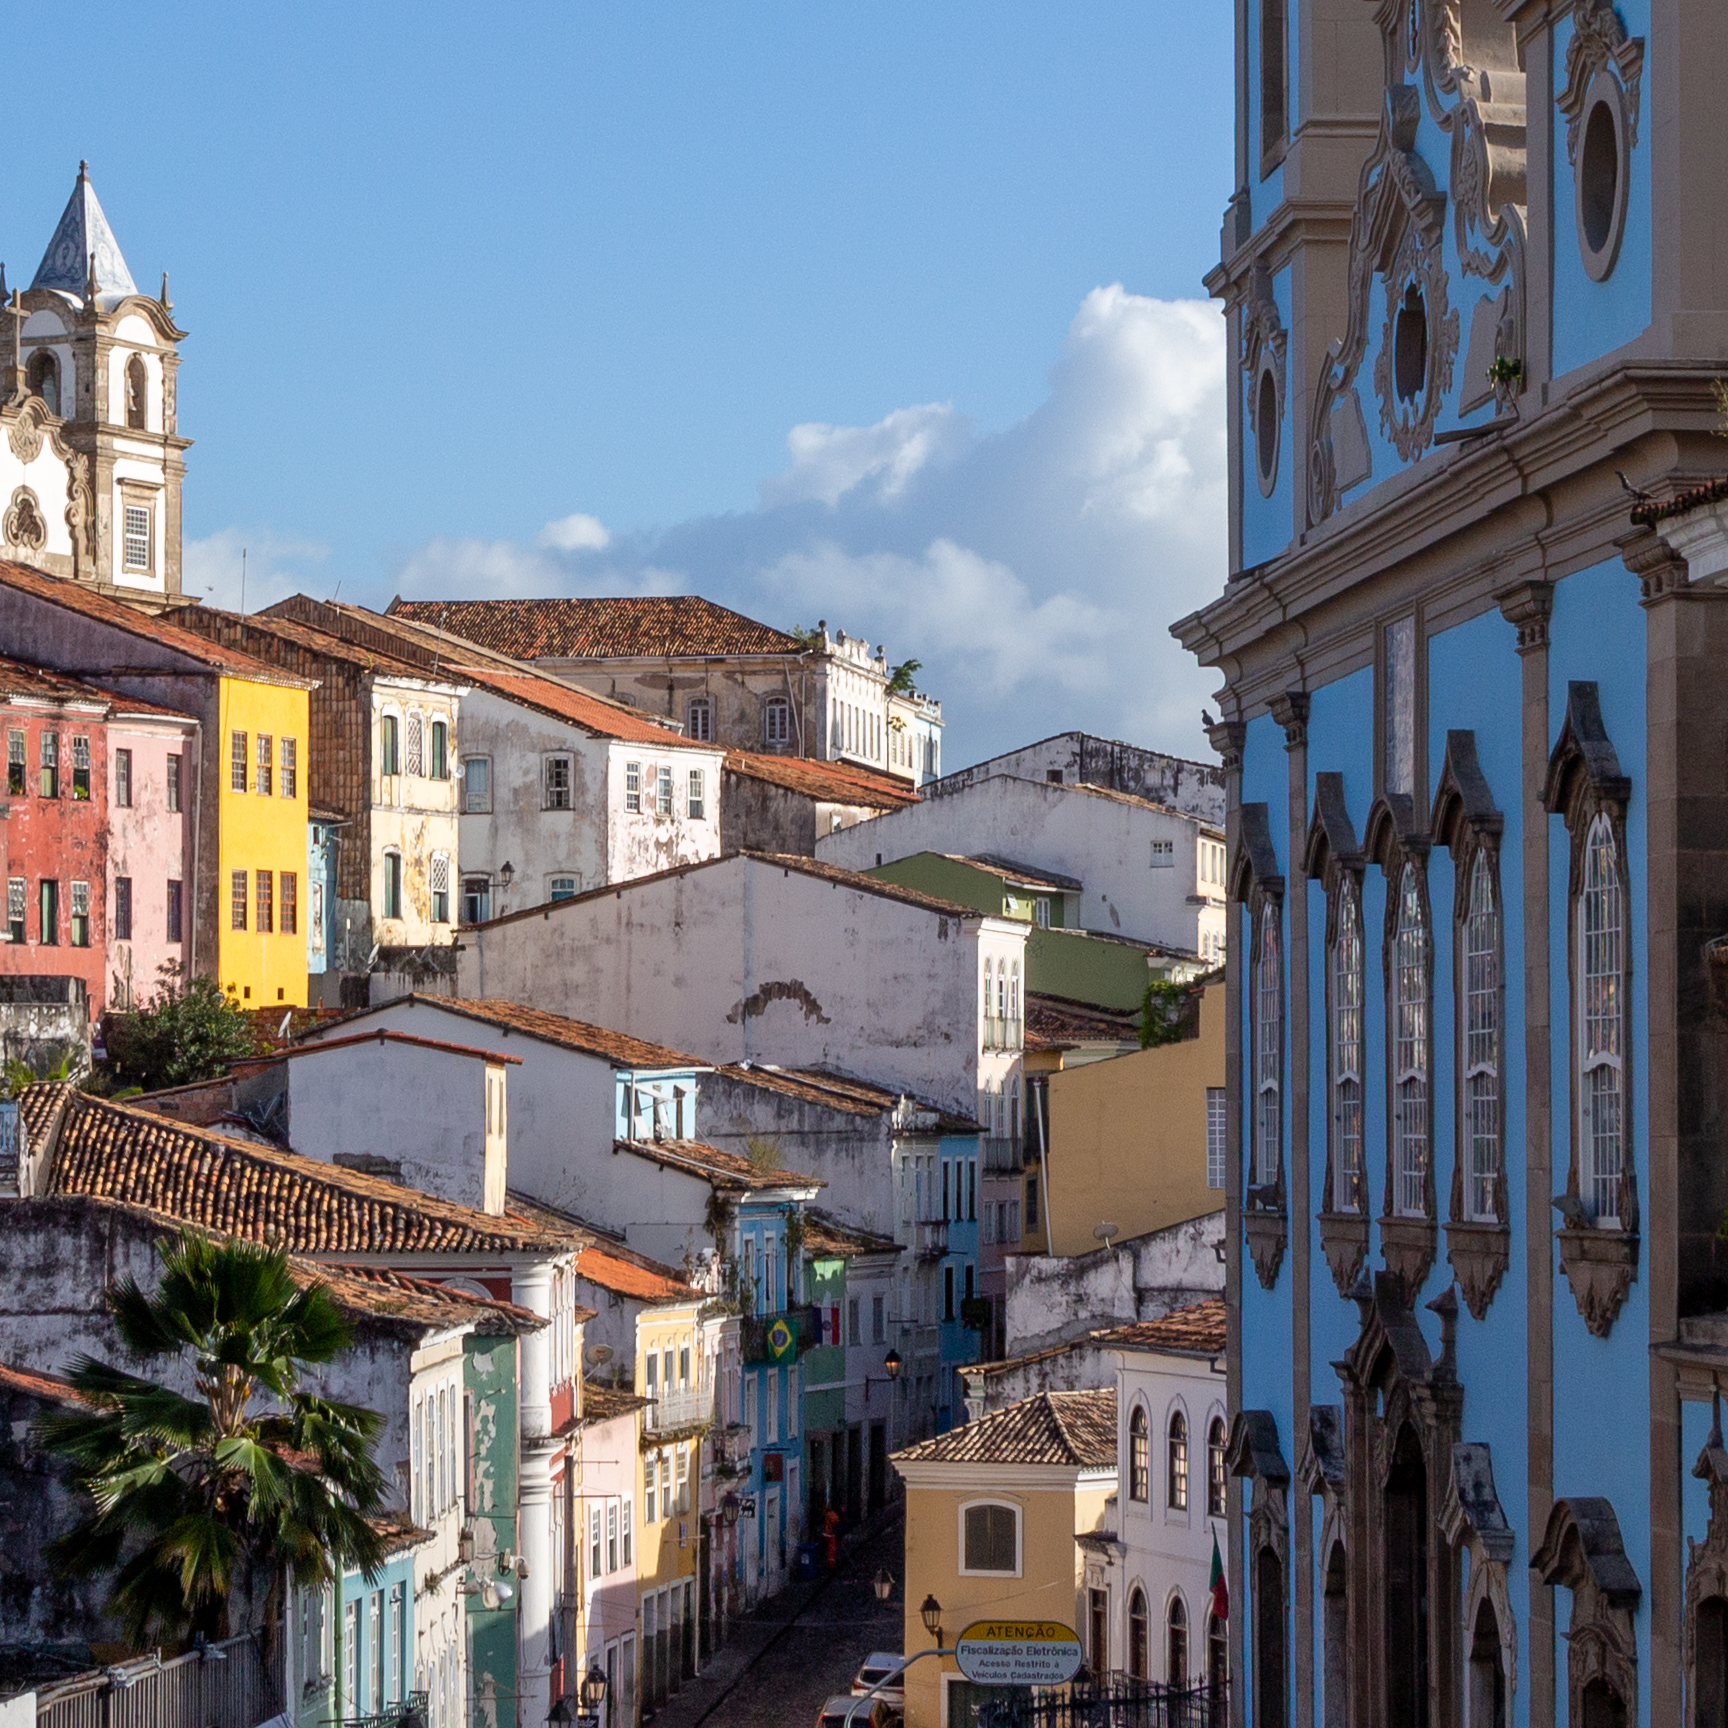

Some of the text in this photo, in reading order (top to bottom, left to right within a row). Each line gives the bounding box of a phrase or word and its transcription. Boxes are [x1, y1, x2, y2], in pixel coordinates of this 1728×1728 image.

[986, 1624, 1055, 1639] ATENÇÃO
[960, 1645, 1078, 1657] Fiscalização Eletrônica
[978, 1660, 1011, 1668] Acesso
[1015, 1660, 1050, 1669] Restrito
[1010, 1671, 1065, 1680] Cadastrados
